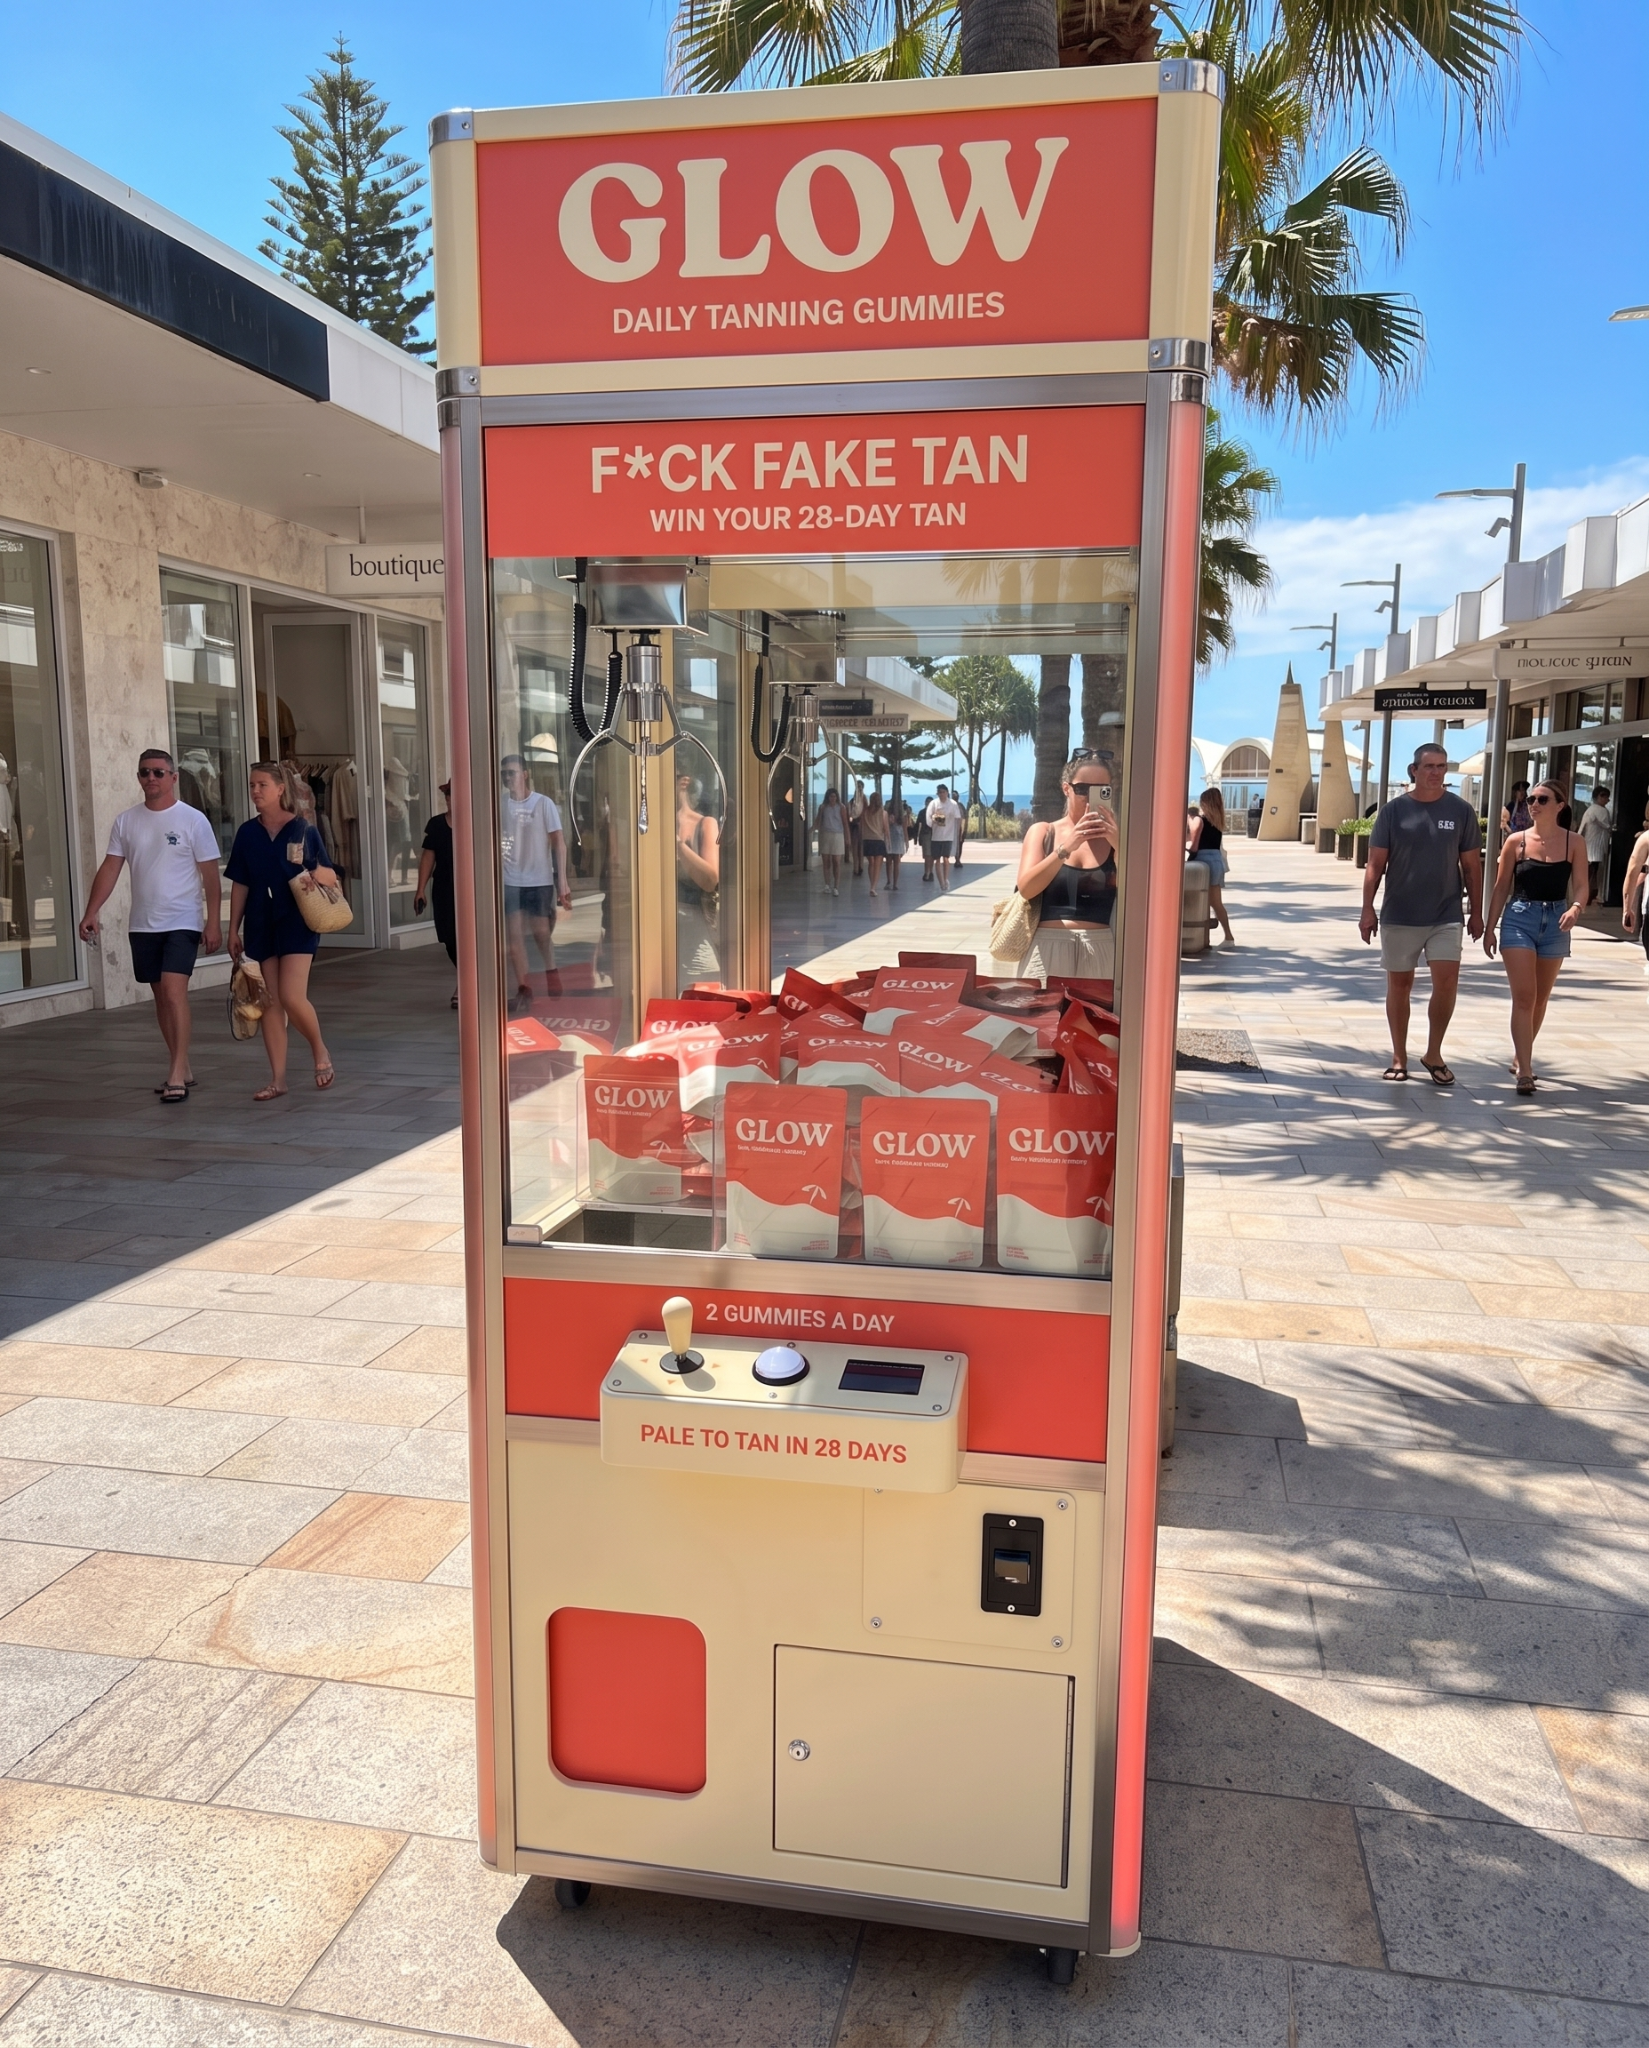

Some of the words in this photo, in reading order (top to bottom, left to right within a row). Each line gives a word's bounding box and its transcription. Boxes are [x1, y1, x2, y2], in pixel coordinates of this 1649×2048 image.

[558, 136, 1070, 284] GLOW
[613, 305, 698, 335] DAILY
[704, 299, 844, 330] TANNING
[853, 291, 1005, 324] GUMMIES
[754, 438, 896, 490] FAKE
[912, 434, 1028, 486] TAN
[649, 508, 705, 533] WIN
[712, 506, 791, 532] YOUR
[798, 503, 903, 530] 28-DAY
[909, 501, 967, 528] TAN
[349, 553, 445, 582] boutique
[882, 979, 955, 990] GLOW
[687, 1033, 770, 1052] GLOW
[897, 1041, 974, 1074] GLOW
[594, 1085, 674, 1109] GLOW
[735, 1117, 833, 1147] GLOW
[872, 1130, 977, 1158] GLOW
[1008, 1126, 1115, 1156] GLOW
[705, 1303, 718, 1321] 2
[724, 1304, 826, 1328] GUMMIES
[831, 1311, 847, 1330] A
[852, 1312, 895, 1333] DAY
[641, 1424, 695, 1447] PALE
[699, 1428, 729, 1449] TO
[734, 1431, 779, 1453] TAN
[786, 1436, 808, 1455] IN
[815, 1438, 841, 1458] 28
[848, 1441, 907, 1464] DAYS
